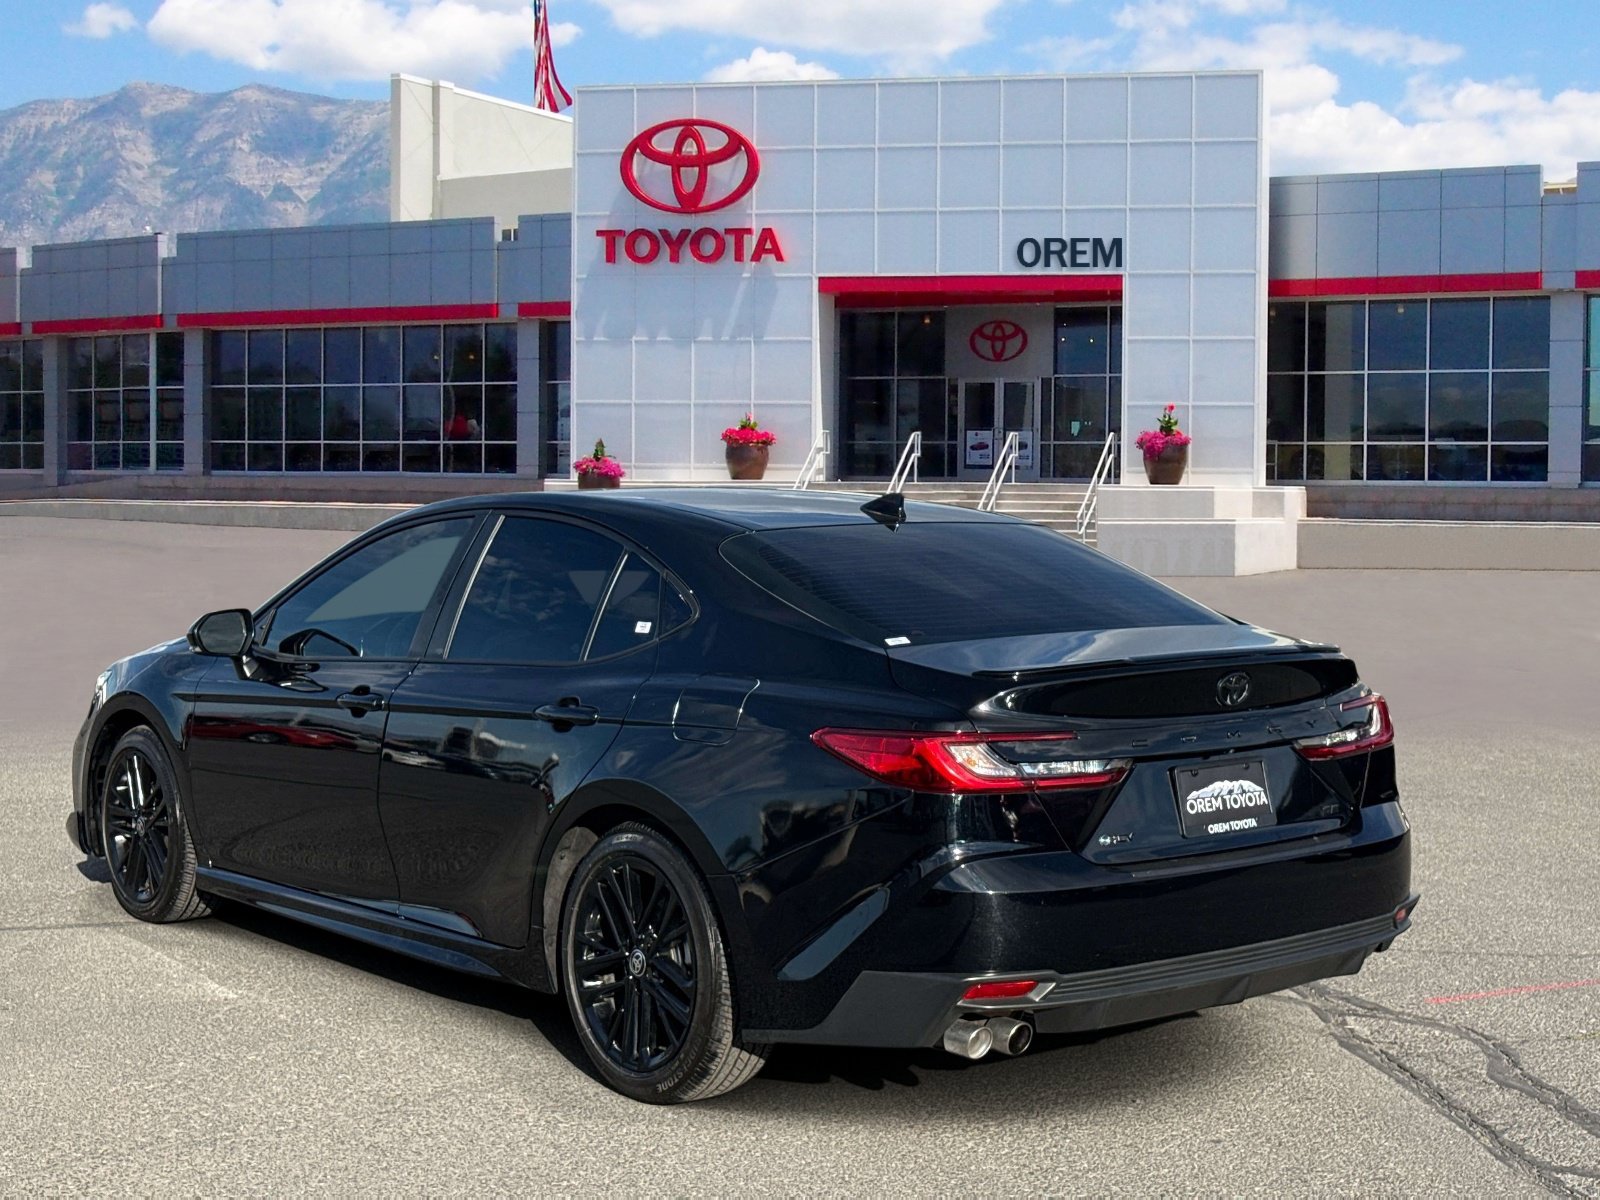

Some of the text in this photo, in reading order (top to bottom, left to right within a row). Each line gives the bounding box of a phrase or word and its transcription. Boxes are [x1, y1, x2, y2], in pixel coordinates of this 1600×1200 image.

[596, 227, 784, 264] TOYOTA
[1017, 237, 1122, 268] OREM
[1186, 791, 1268, 814] OREM TOYOTA
[1207, 817, 1258, 834] OREM TOYOTA
